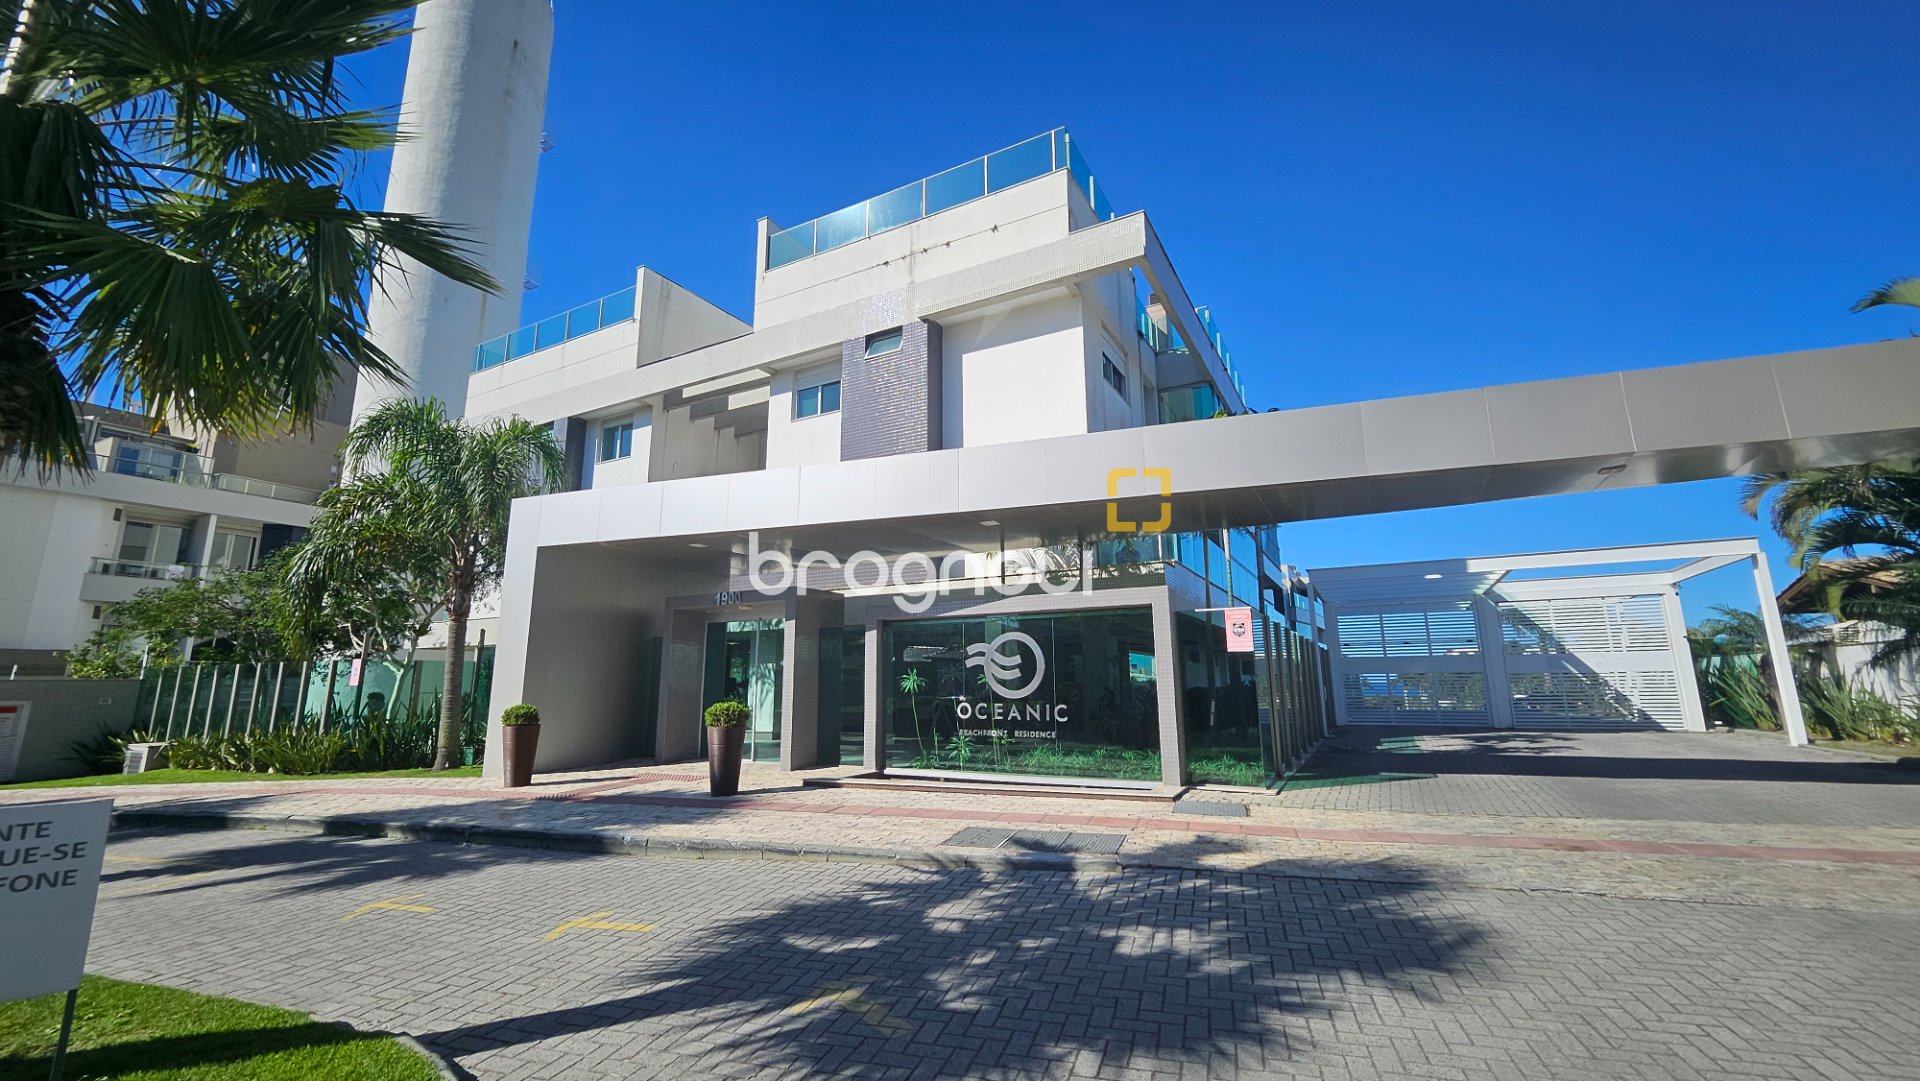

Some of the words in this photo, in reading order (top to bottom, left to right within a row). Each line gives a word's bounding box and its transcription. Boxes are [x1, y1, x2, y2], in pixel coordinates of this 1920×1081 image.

[714, 591, 742, 606] 1900
[956, 702, 1069, 722] OCEANIC
[959, 729, 1008, 738] BEACHFRONT
[1014, 730, 1056, 739] RESIDENCE
